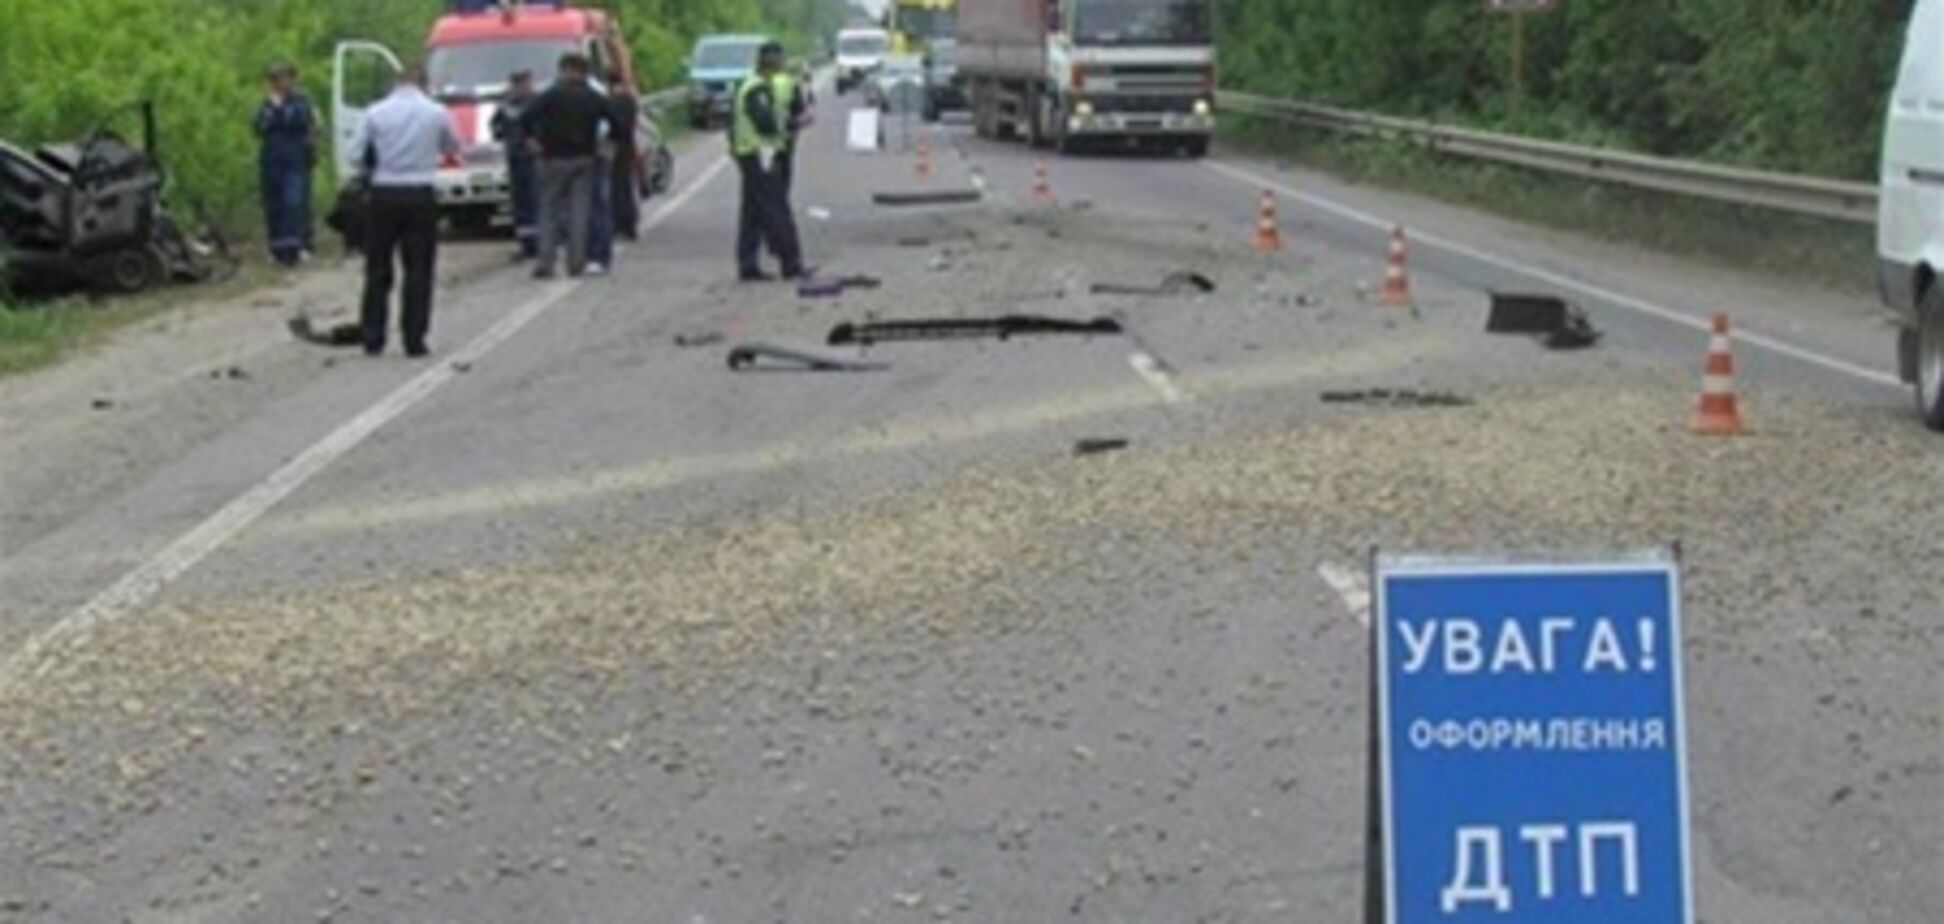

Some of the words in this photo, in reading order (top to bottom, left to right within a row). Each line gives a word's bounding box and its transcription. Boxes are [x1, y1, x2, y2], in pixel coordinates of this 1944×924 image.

[1398, 617, 1656, 673] УВАГА!
[1409, 718, 1666, 749] ОФОРМЛЕННЯ
[1441, 821, 1639, 912] ДТП
